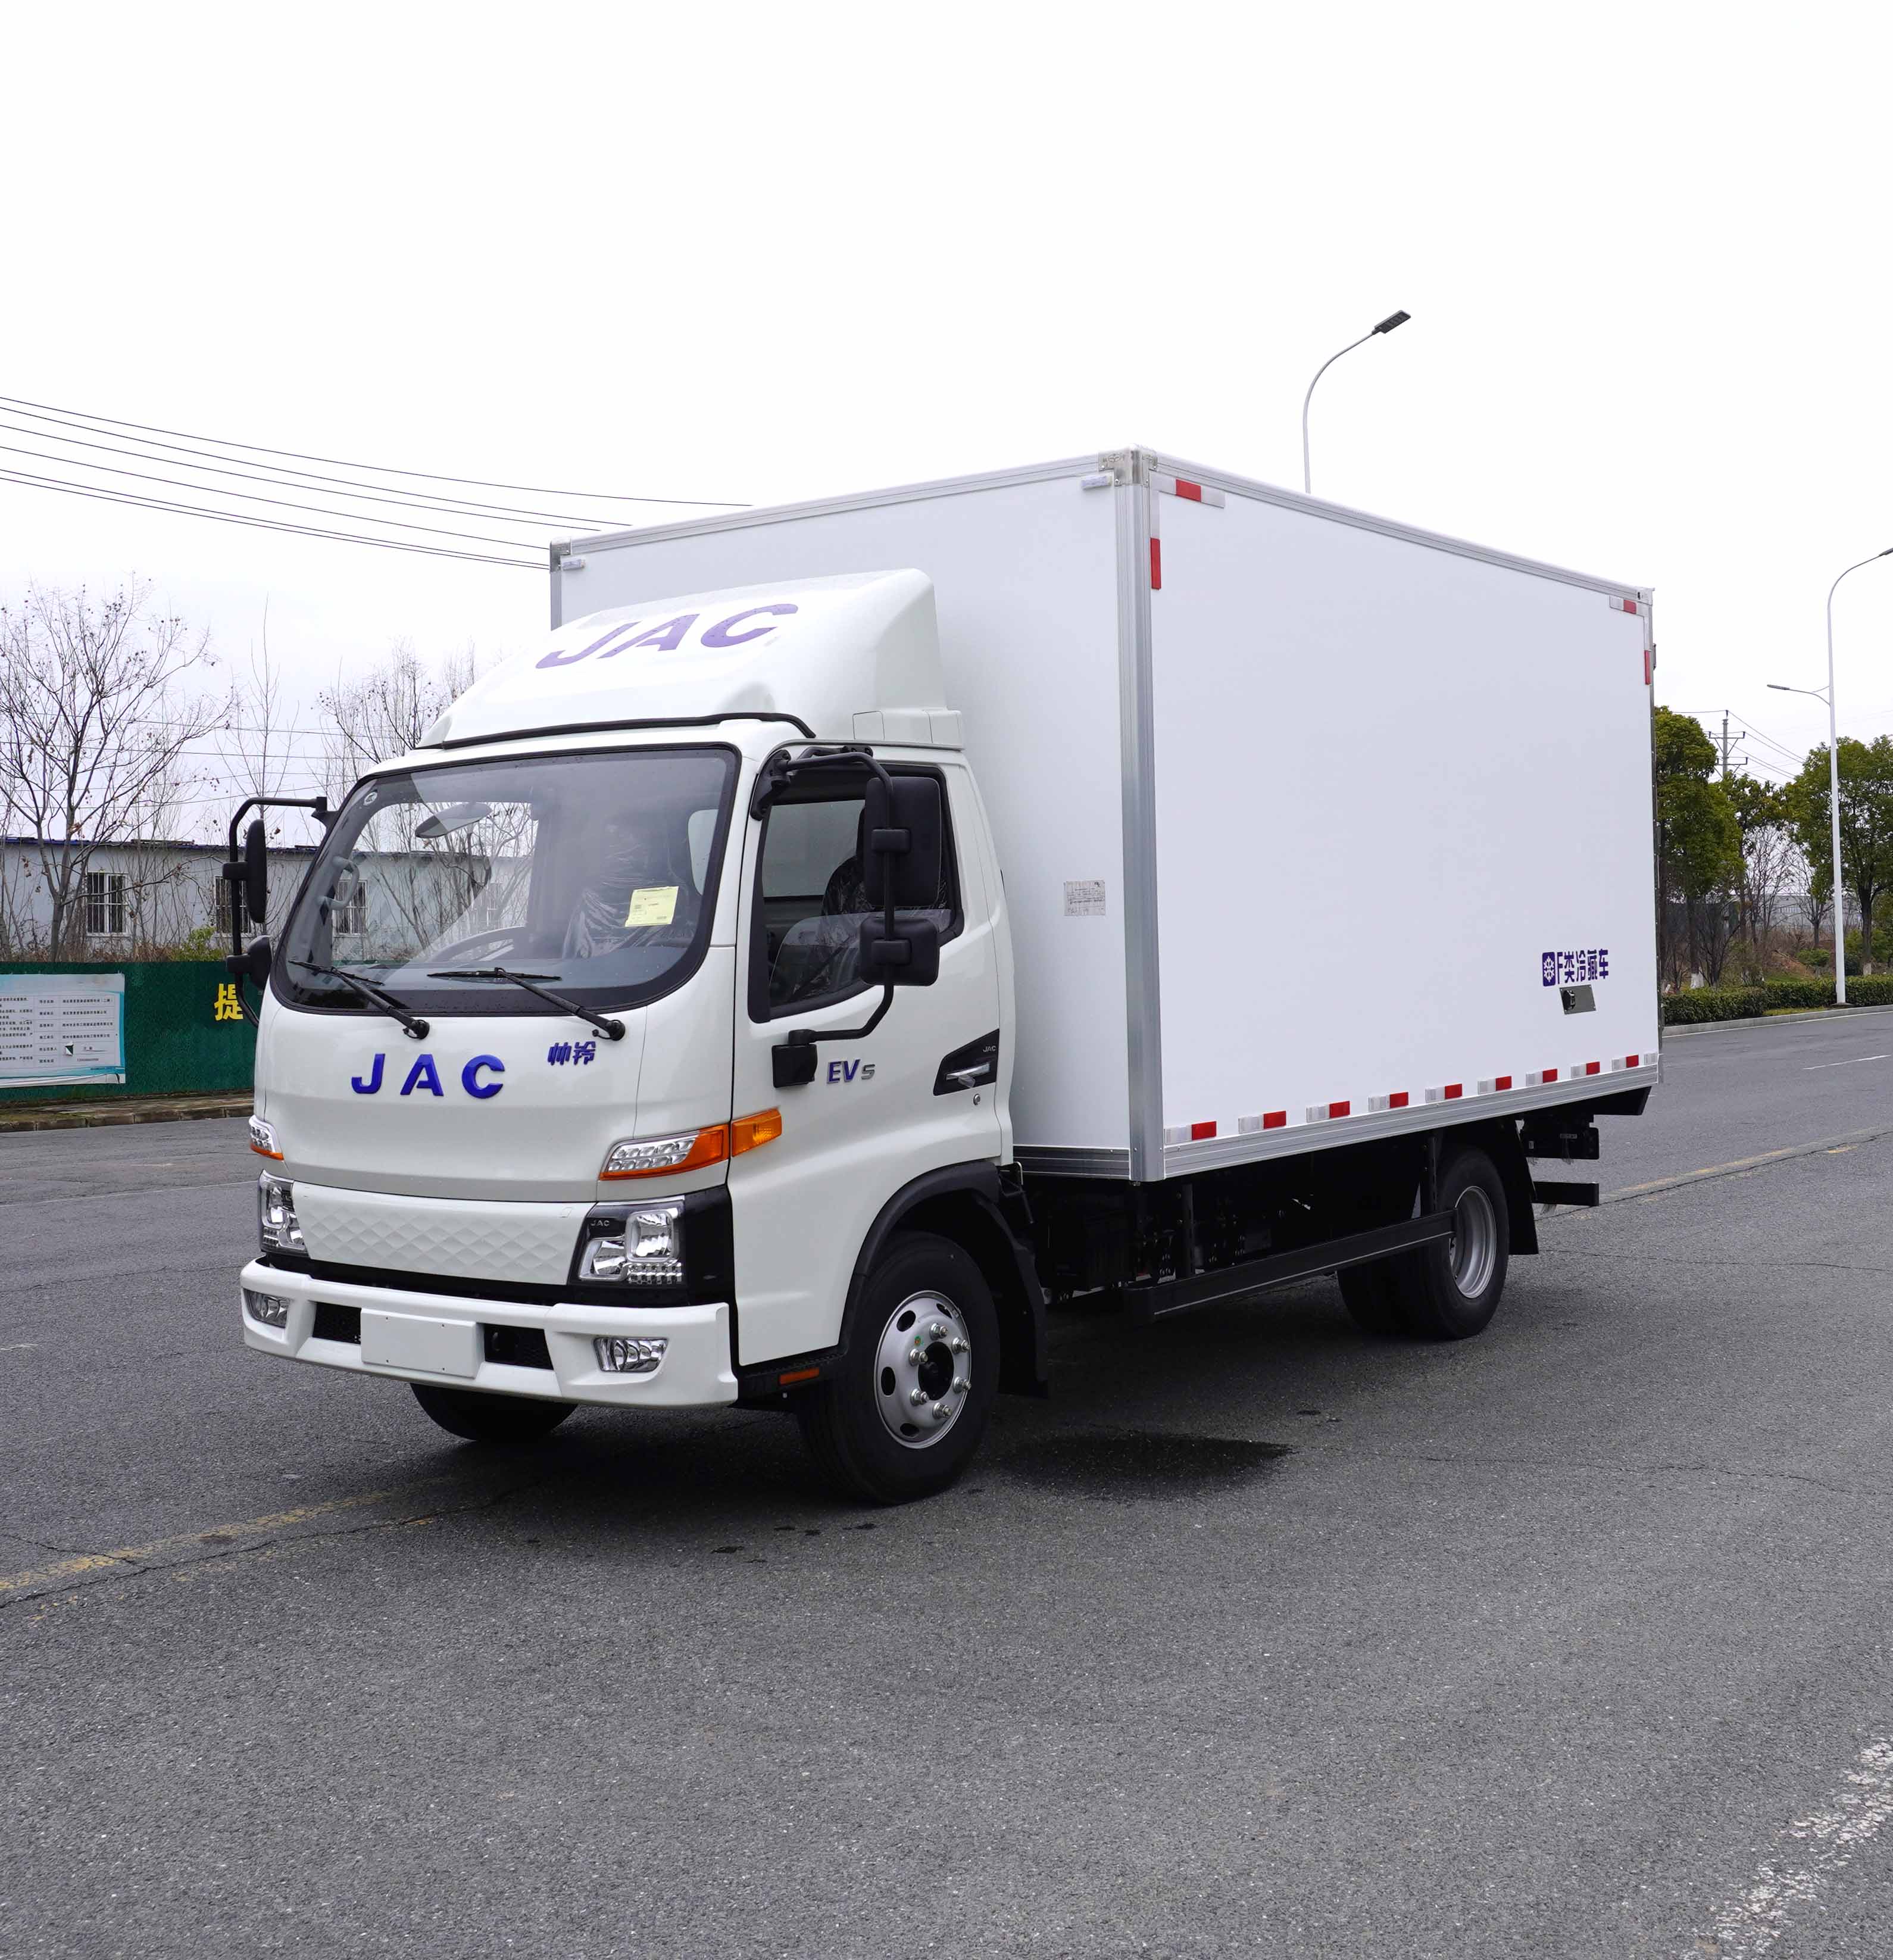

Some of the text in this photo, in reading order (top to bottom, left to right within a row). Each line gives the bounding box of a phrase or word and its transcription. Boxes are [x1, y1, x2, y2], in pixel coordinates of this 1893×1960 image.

[536, 603, 798, 669] JAC
[1557, 948, 1608, 984] F类冷藏车
[214, 983, 243, 1020] 提
[548, 1041, 596, 1065] 帅铃
[351, 1053, 505, 1099] JAC
